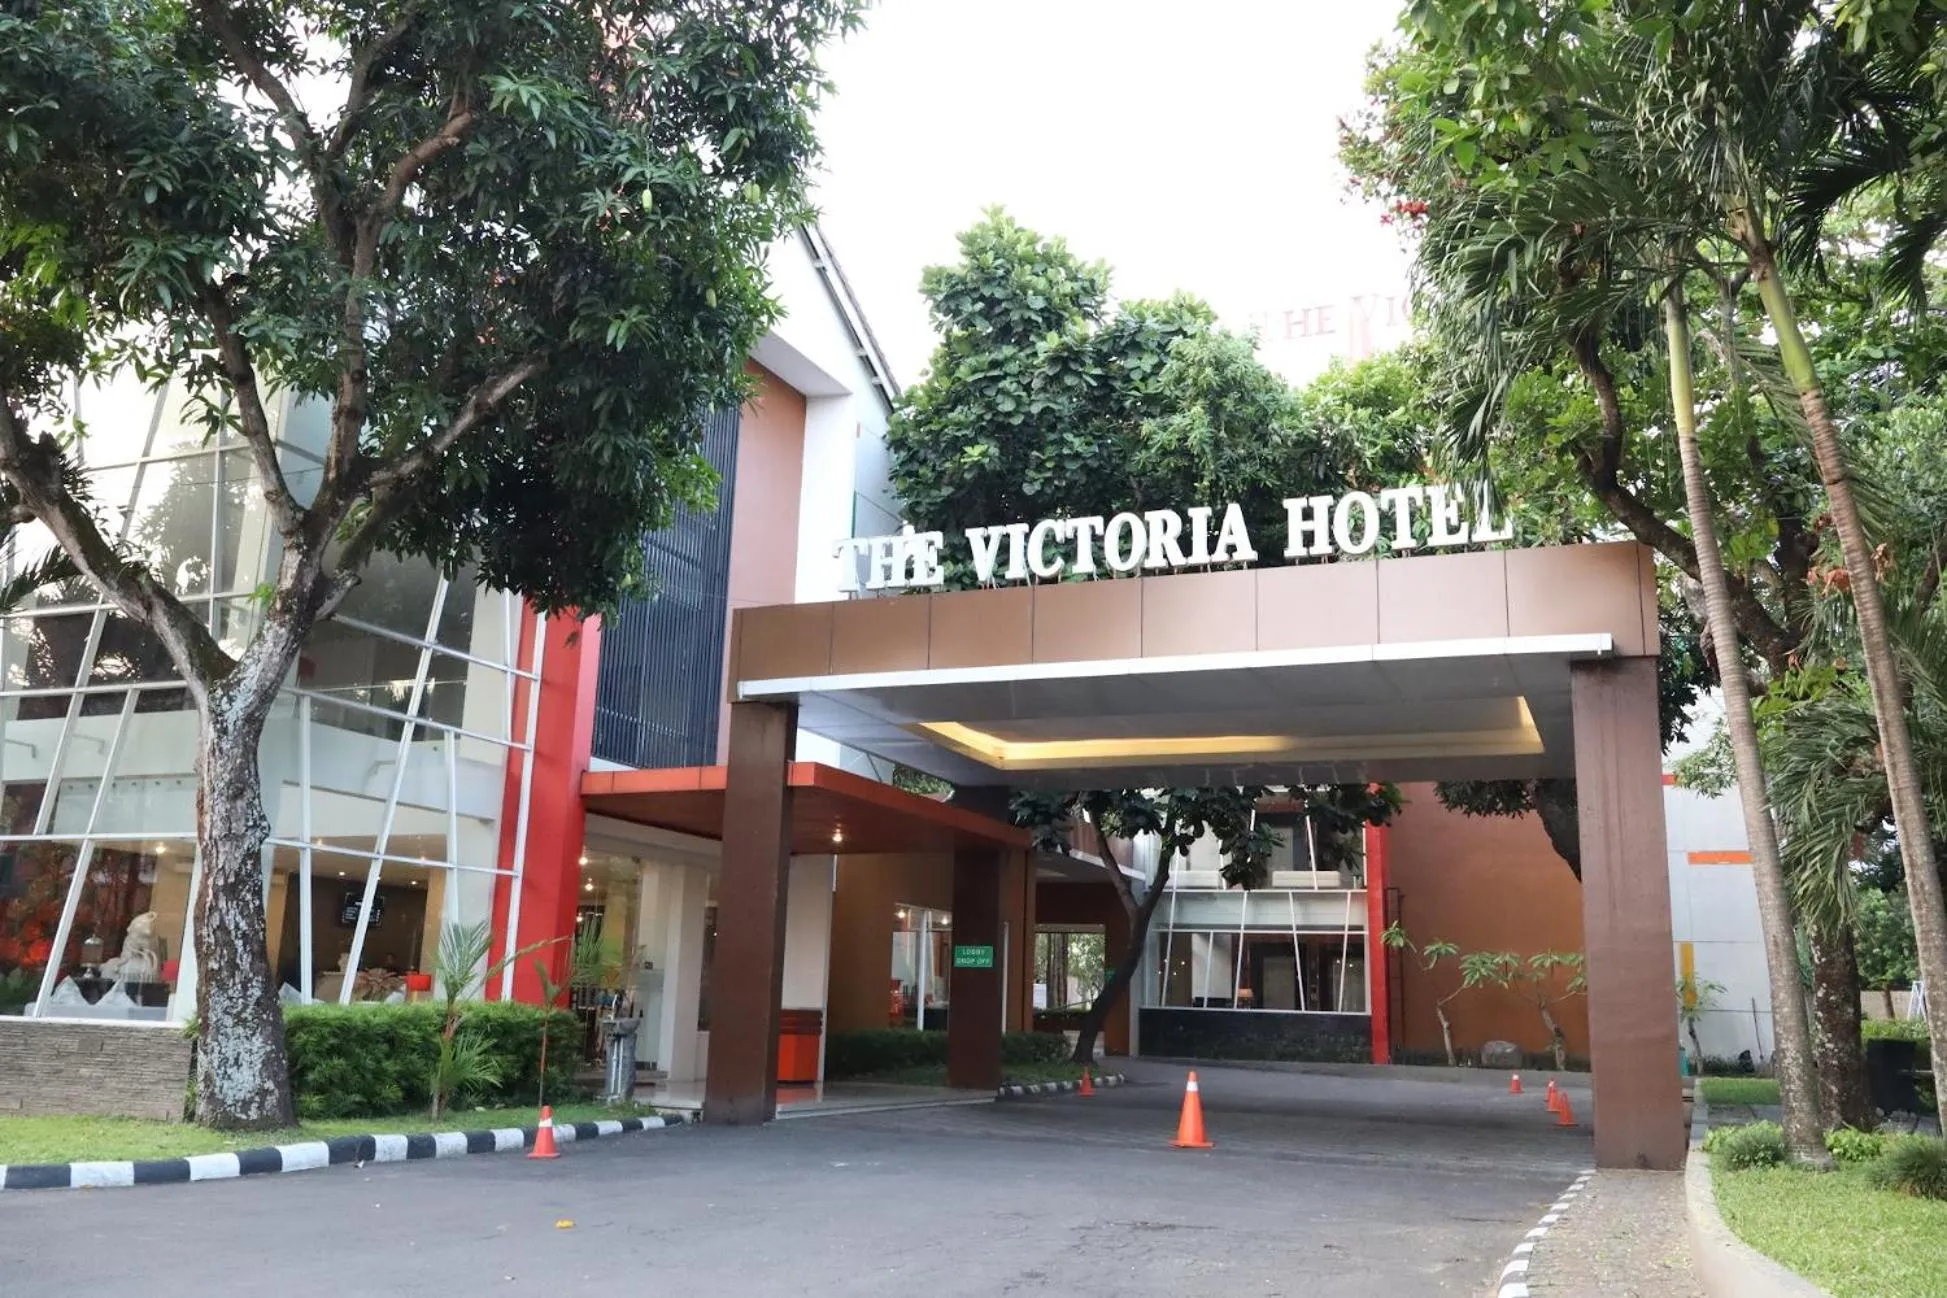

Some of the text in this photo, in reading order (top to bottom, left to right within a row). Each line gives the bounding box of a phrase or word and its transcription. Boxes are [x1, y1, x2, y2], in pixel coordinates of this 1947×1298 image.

[832, 480, 1513, 592] THE VICTORIA HOTEL
